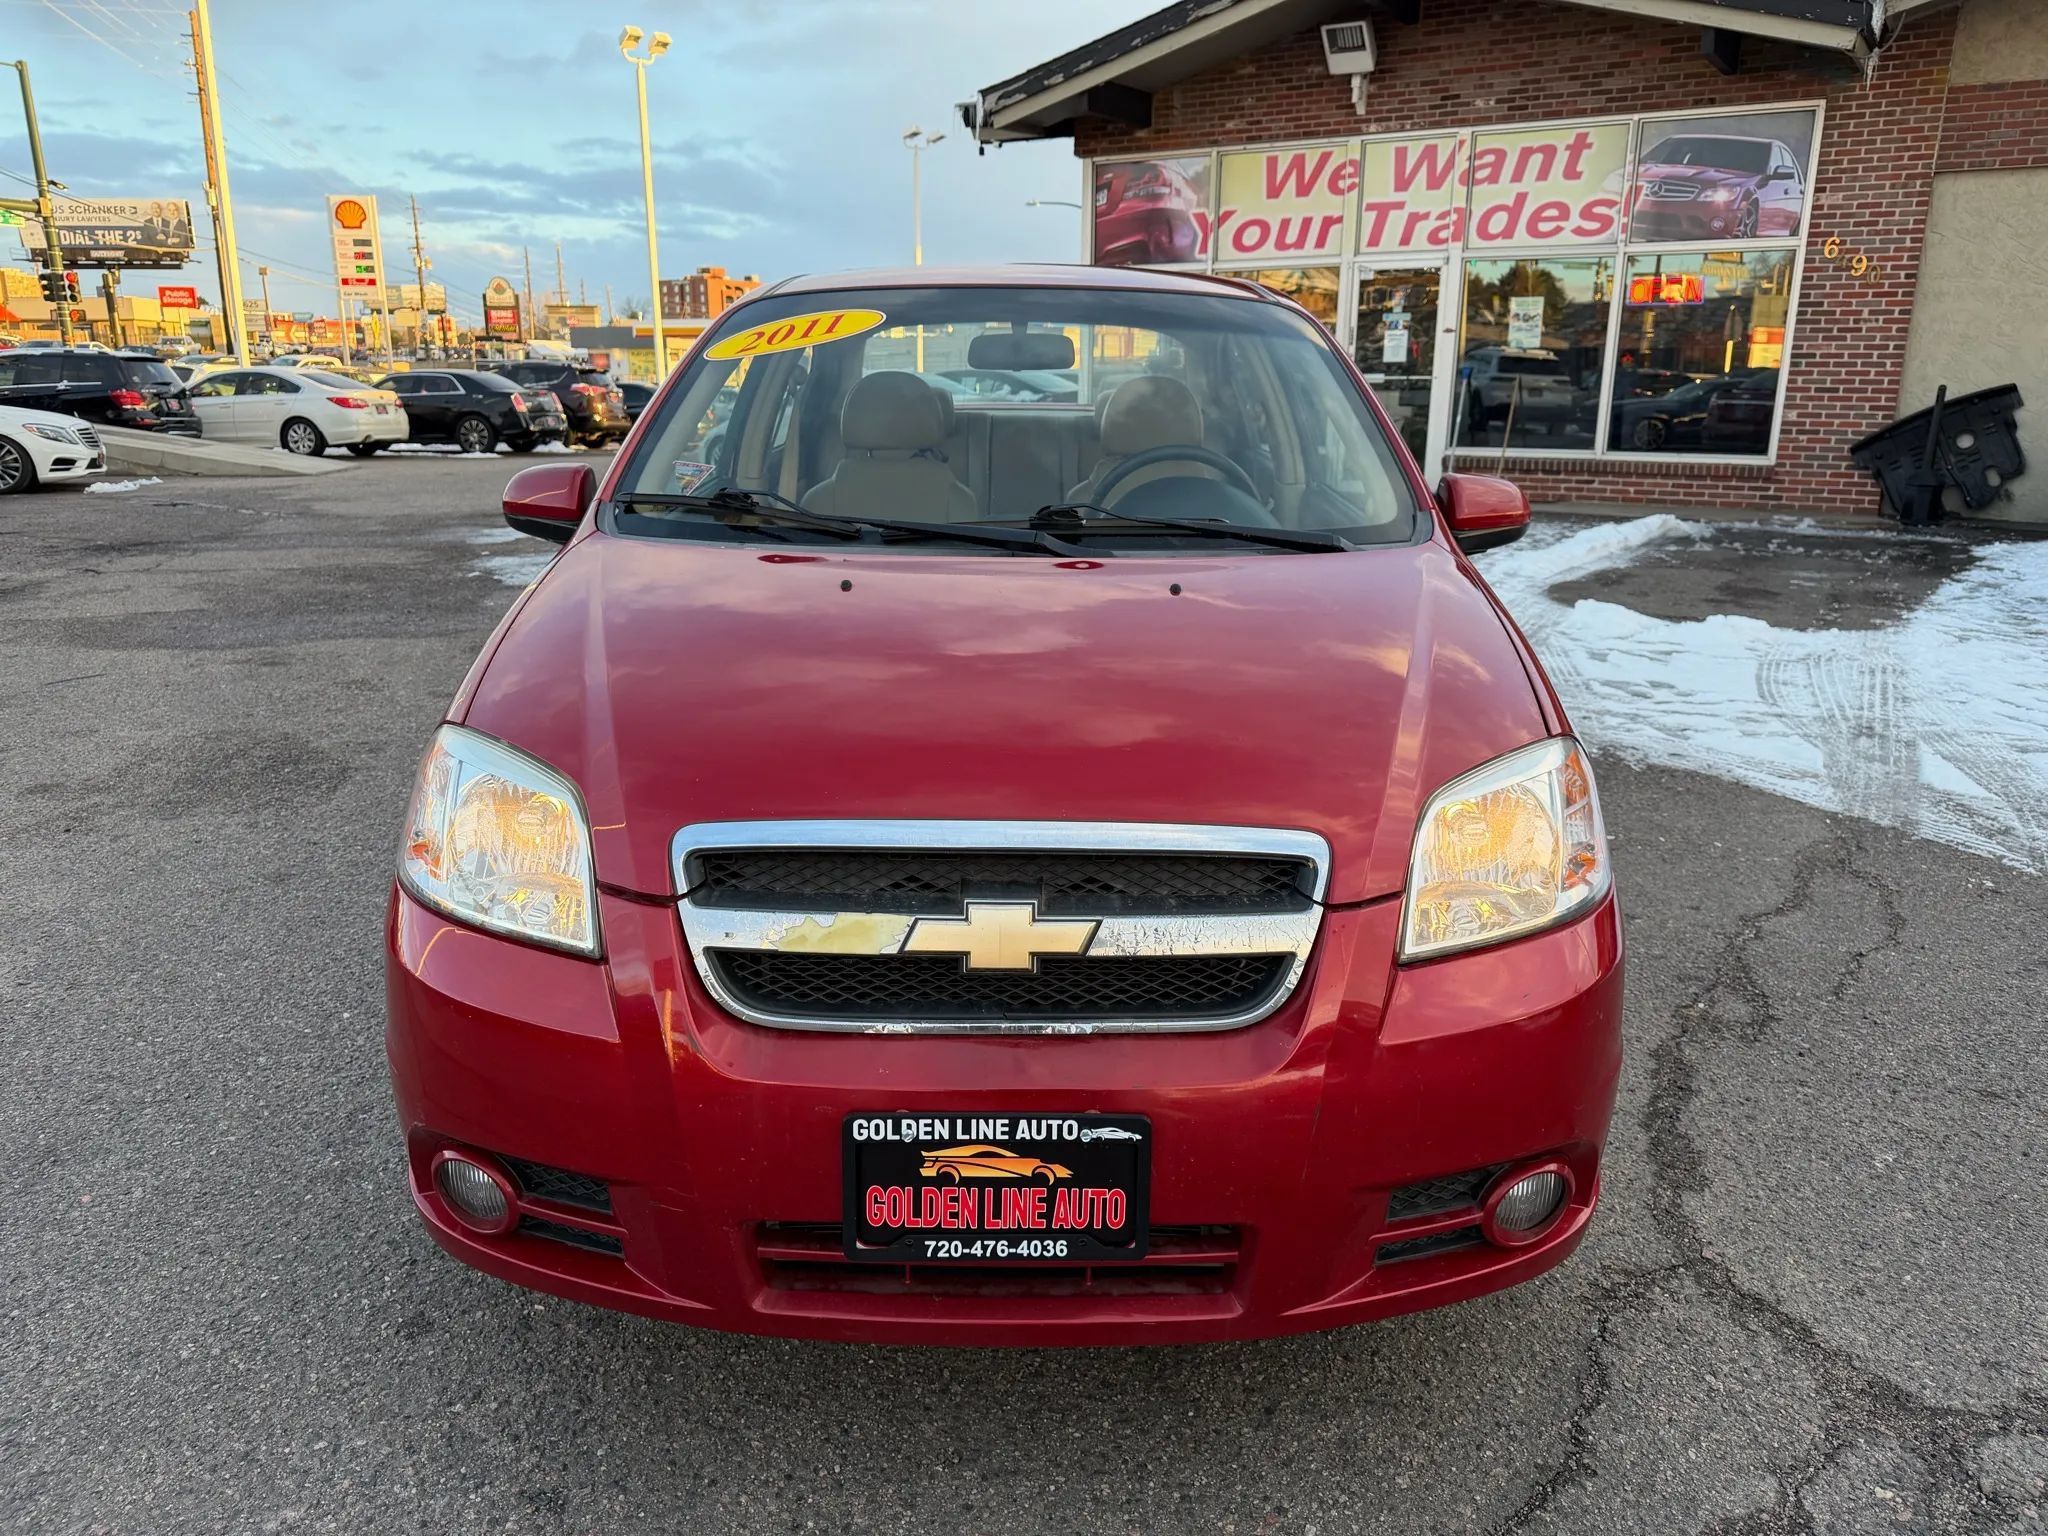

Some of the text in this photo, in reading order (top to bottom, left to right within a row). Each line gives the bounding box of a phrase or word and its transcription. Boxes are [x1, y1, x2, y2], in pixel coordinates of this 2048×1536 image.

[1265, 132, 1595, 200] We Want
[68, 205, 127, 215] SCHANKER
[1192, 185, 1644, 257] Your Trades!
[59, 229, 95, 246] DIAL
[94, 229, 125, 246] THE
[735, 312, 846, 355] 2011
[852, 1118, 1079, 1142] GOLDEN LINE AUTO
[866, 1185, 1126, 1229] GOLDEN LINE AUTO
[924, 1240, 1068, 1258] 720-476-4036
